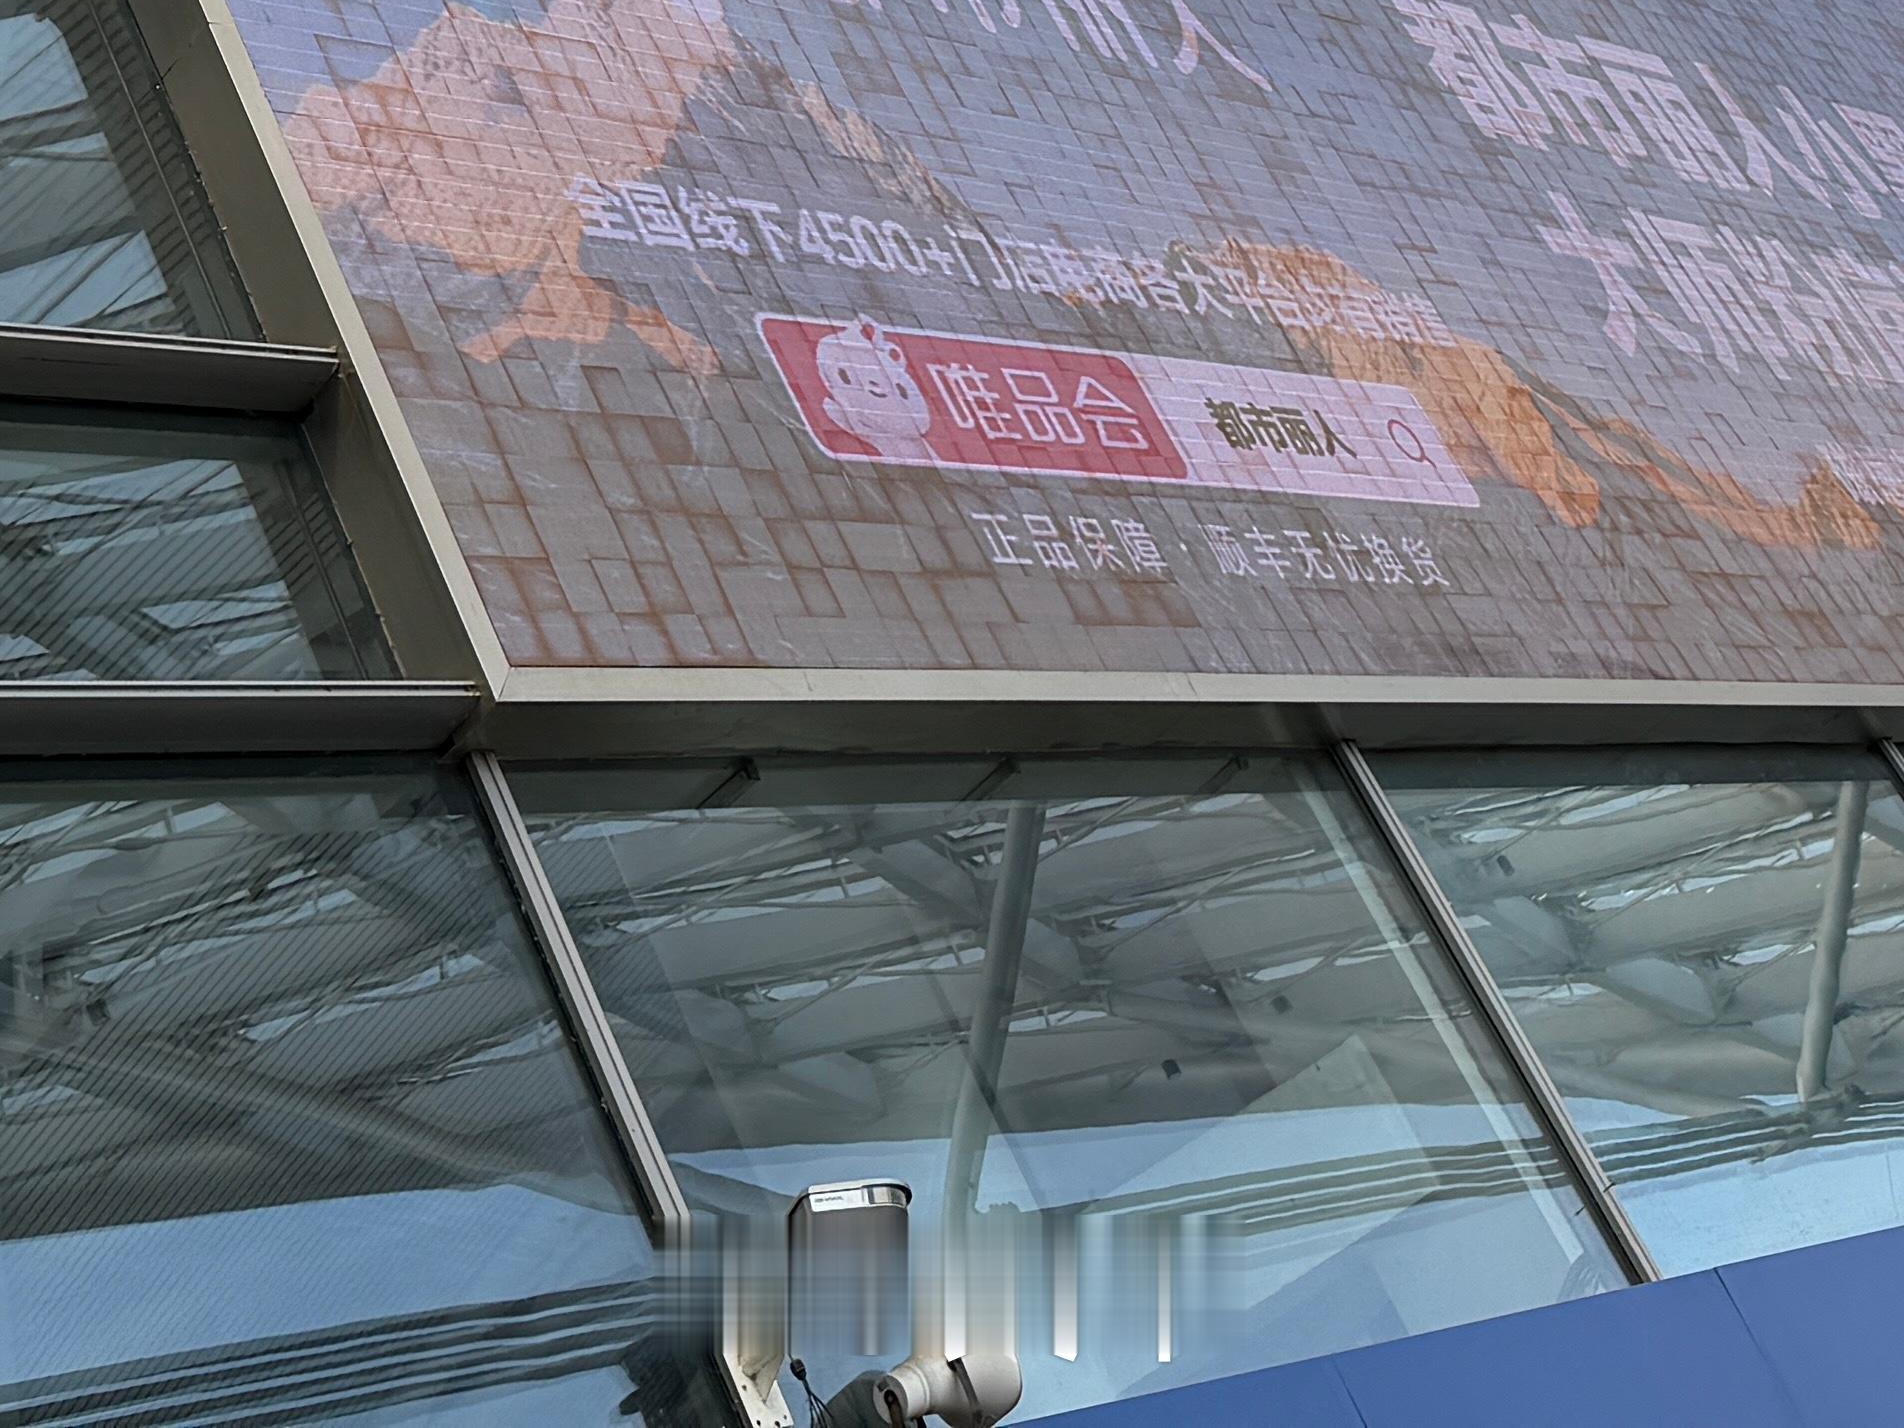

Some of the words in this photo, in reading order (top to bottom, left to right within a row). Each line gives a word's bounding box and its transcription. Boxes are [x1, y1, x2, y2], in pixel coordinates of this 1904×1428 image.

[927, 361, 1150, 450] 唯品会
[1205, 396, 1358, 461] 都市丽人
